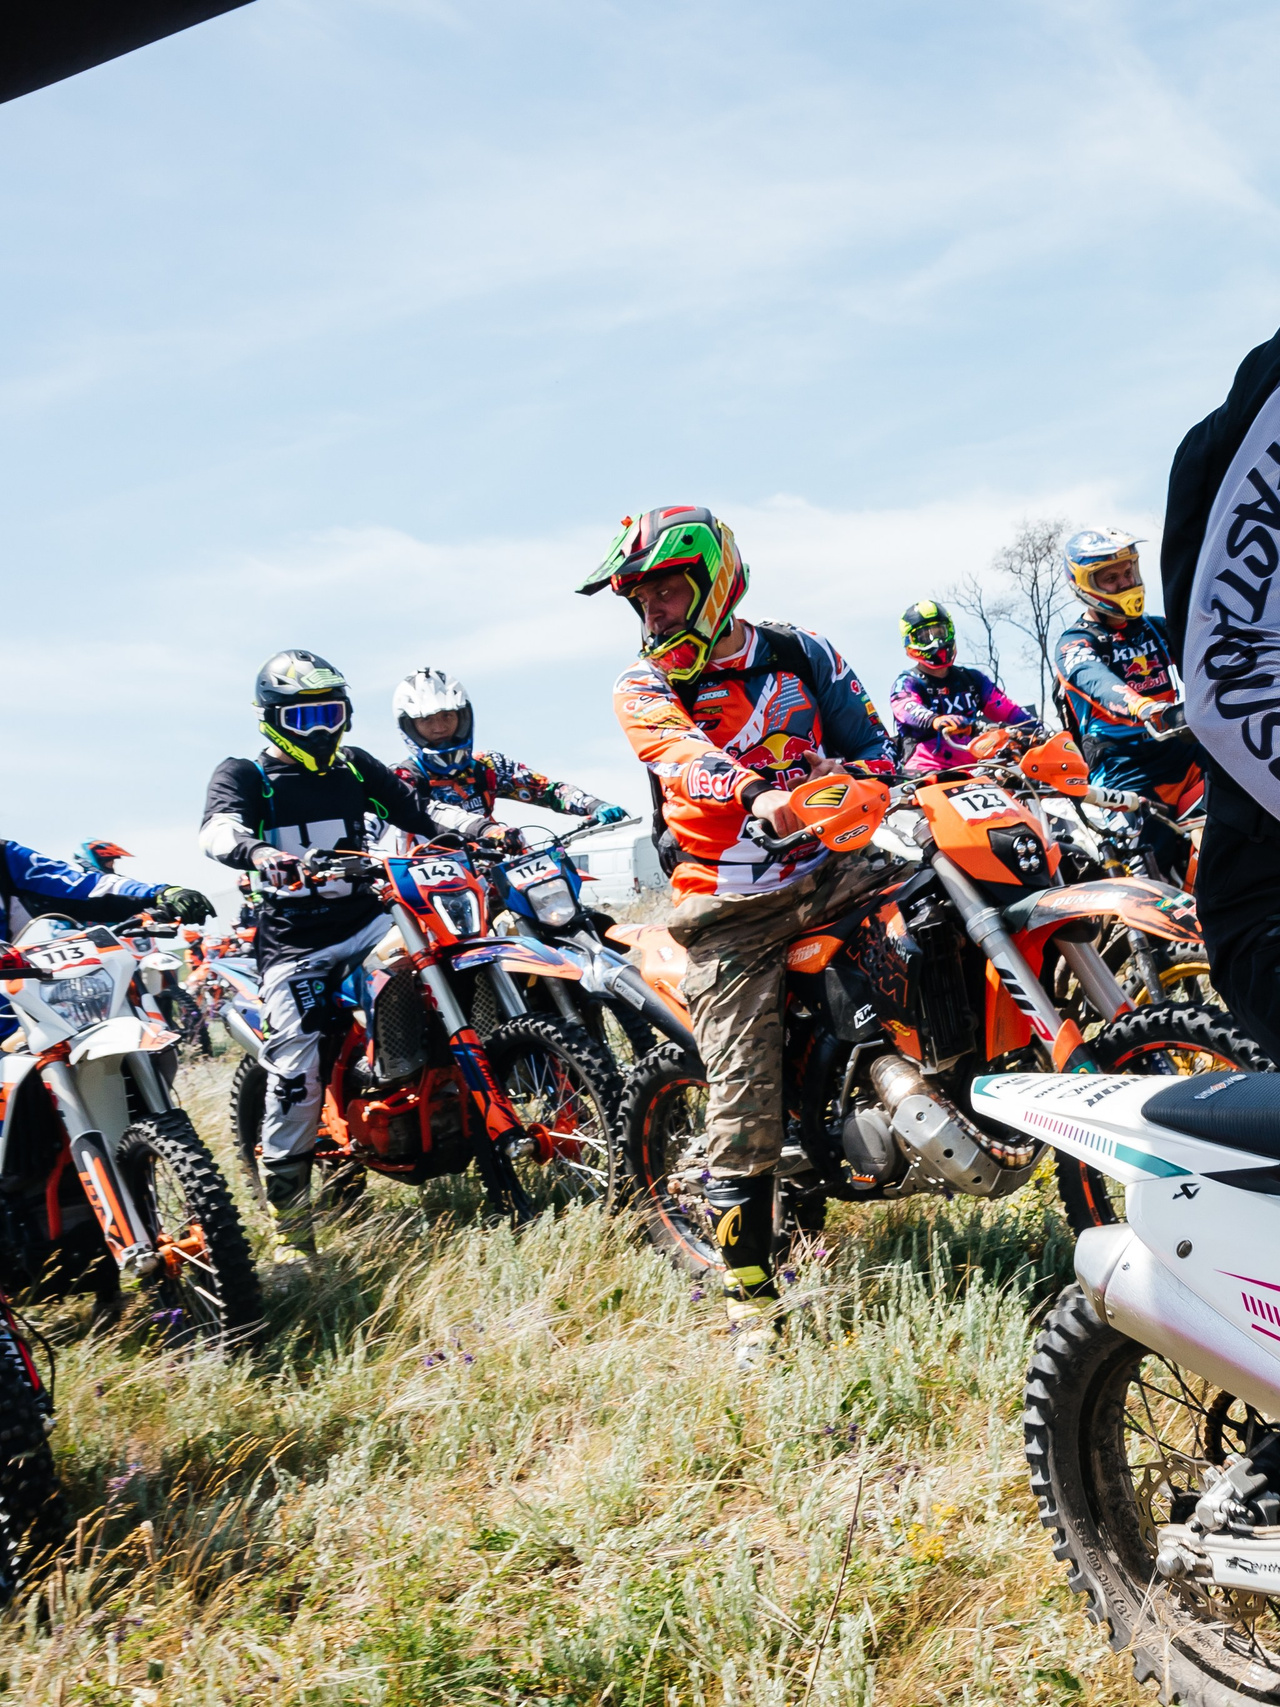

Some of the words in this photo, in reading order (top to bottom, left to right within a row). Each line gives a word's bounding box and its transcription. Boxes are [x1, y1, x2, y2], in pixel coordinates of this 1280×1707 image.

[961, 793, 1008, 813] 123
[418, 864, 459, 881] 142
[516, 861, 548, 880] 114
[42, 946, 85, 964] 113
